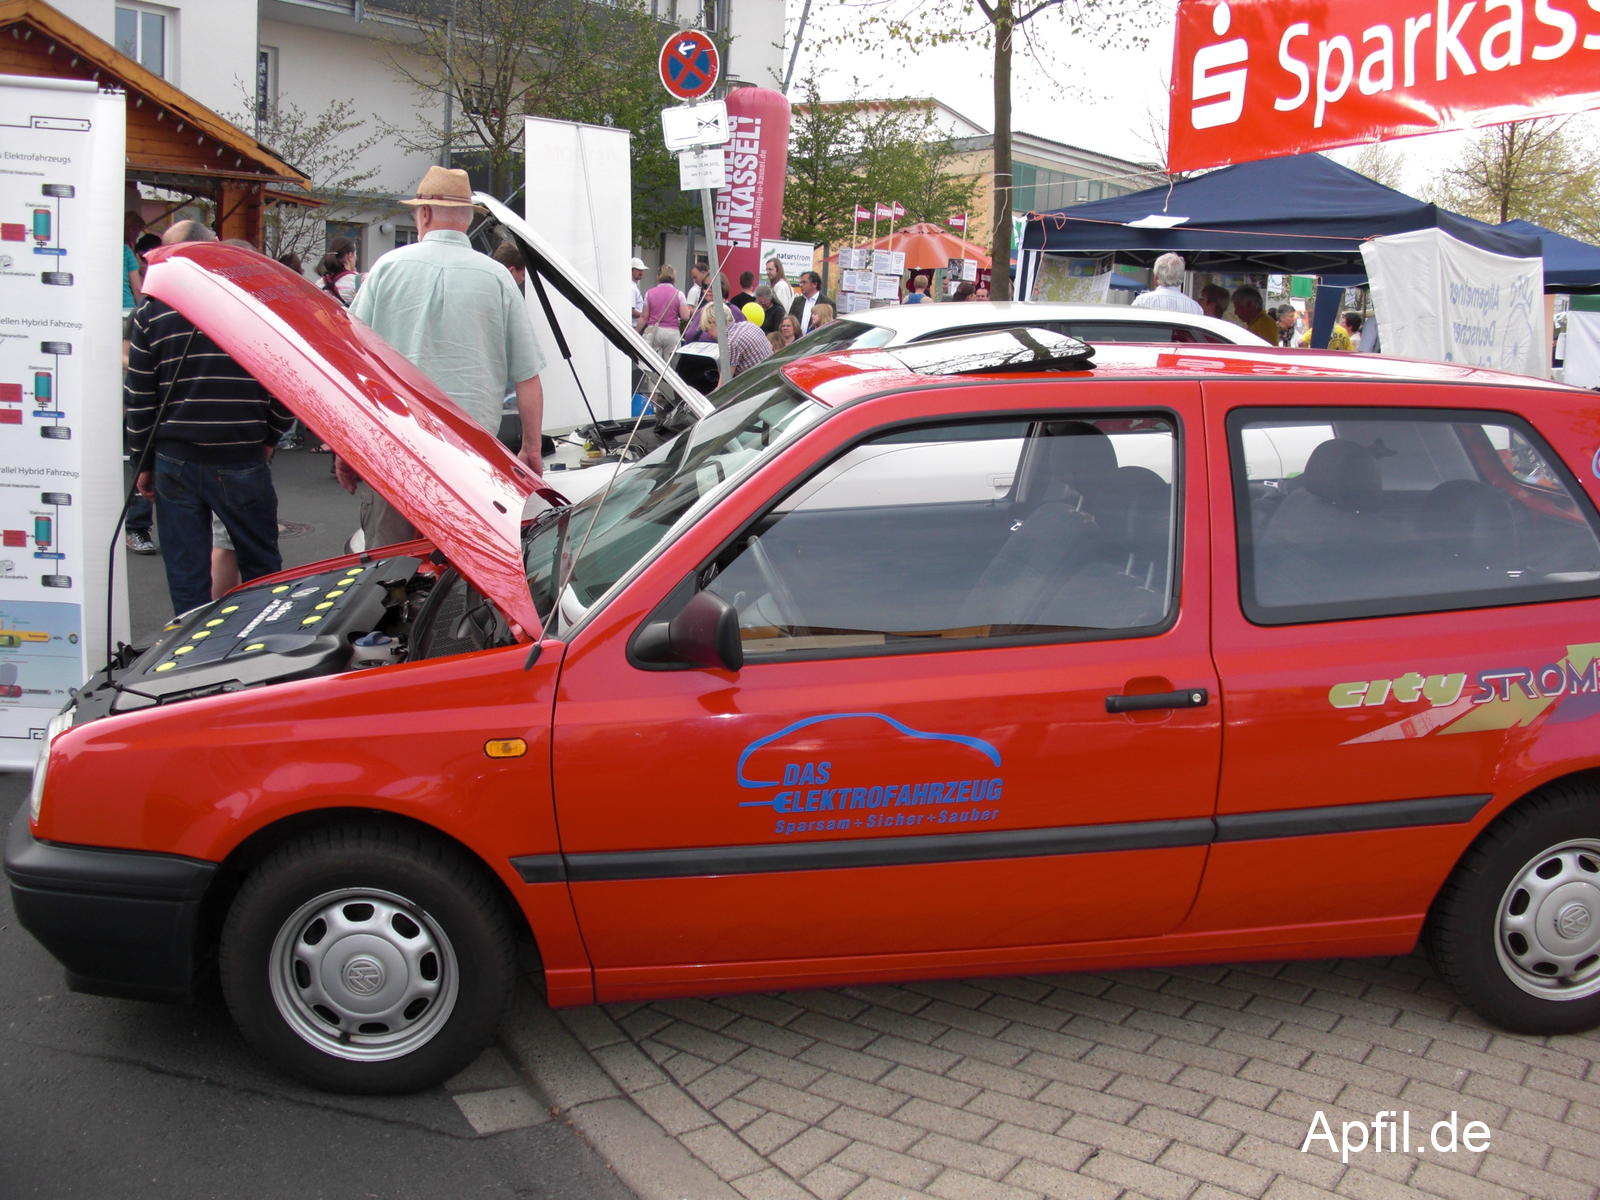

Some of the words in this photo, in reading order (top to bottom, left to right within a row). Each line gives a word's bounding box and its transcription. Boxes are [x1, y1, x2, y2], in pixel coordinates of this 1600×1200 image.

[4, 151, 72, 165] Elektrofahrzeugs
[776, 252, 811, 262] naturstrom
[21, 317, 48, 328] Hybrid
[18, 467, 45, 476] Hybrid
[1328, 671, 1468, 709] city
[1473, 656, 1600, 704] STROM
[783, 761, 832, 787] DAS
[773, 777, 1004, 814] ELEKTROFAHRZEUG
[774, 818, 850, 835] Sparsam
[866, 812, 924, 828] Sicher
[938, 808, 999, 824] Sauber
